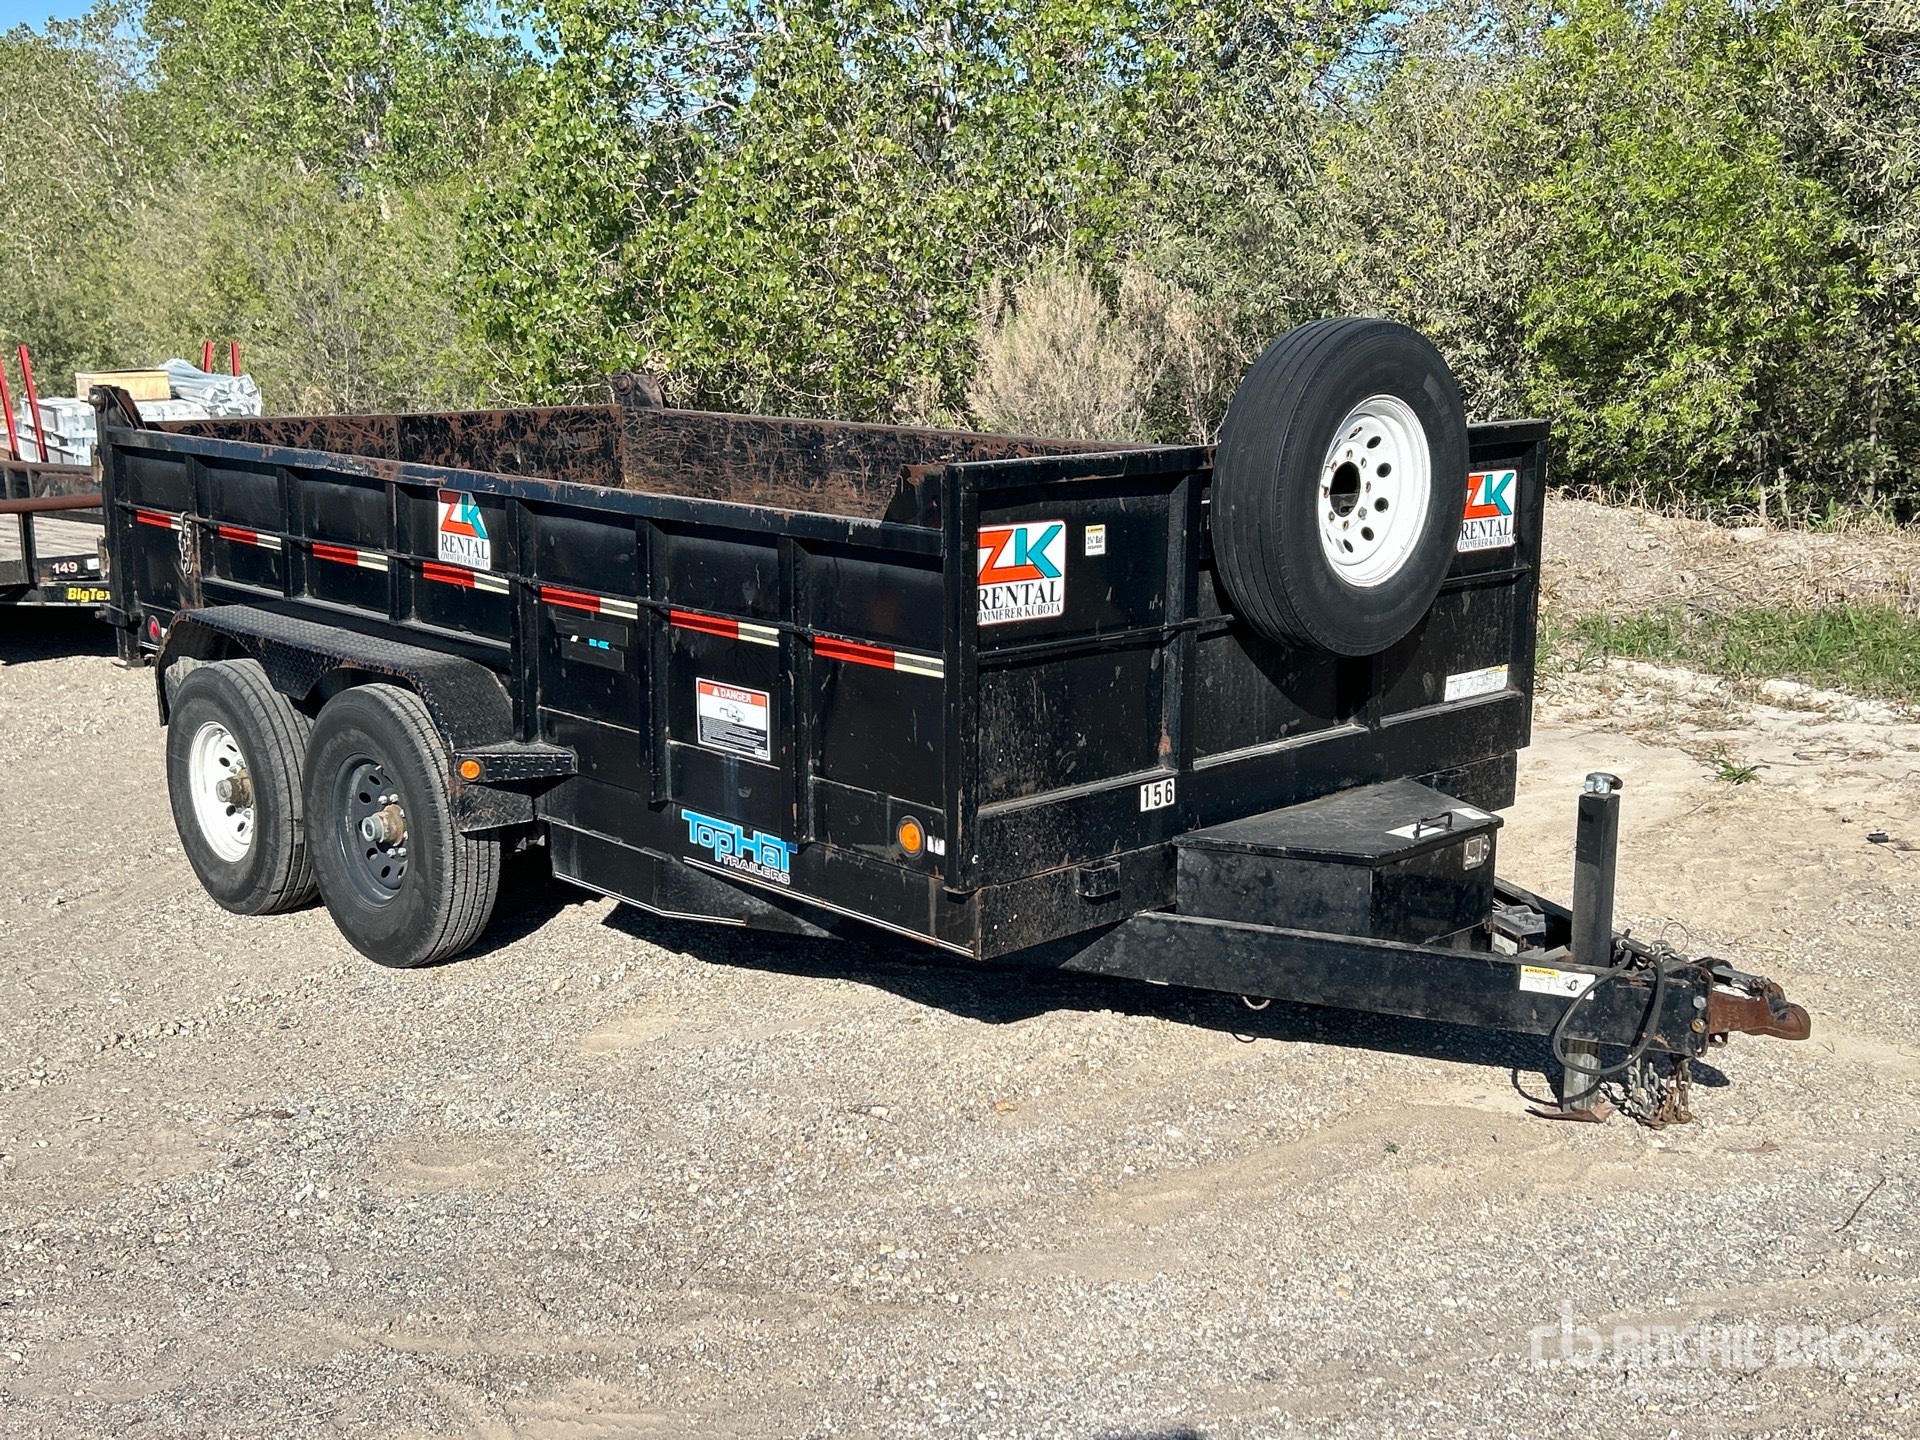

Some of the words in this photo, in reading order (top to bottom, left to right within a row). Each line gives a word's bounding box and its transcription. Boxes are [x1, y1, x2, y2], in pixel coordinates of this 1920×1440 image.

[1463, 473, 1515, 520] ZK
[439, 489, 489, 540] ZK
[1461, 518, 1512, 541] RENTAL
[441, 533, 489, 559] RENTAL
[977, 524, 1063, 586] ZK
[52, 561, 78, 574] 149
[977, 580, 1062, 612] RENTAL
[1024, 602, 1061, 617] KUBOTA
[720, 687, 752, 704] DANGER
[1143, 780, 1173, 808] 156
[721, 853, 791, 885] TRAILERS
